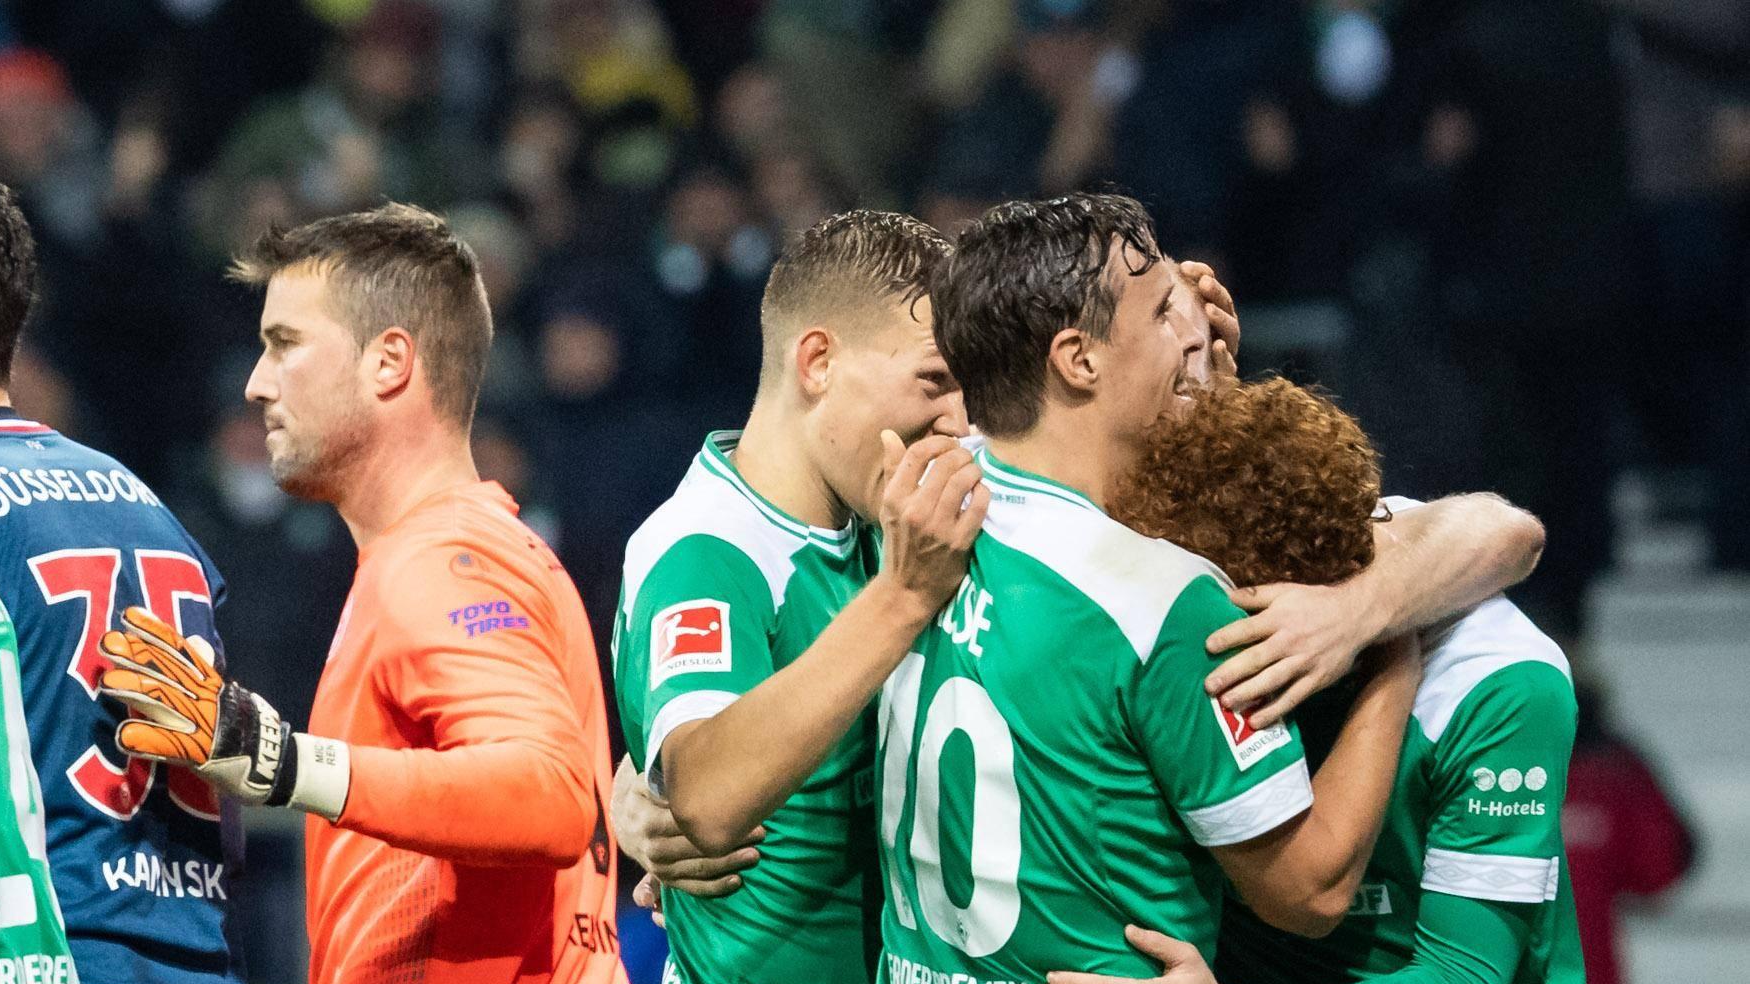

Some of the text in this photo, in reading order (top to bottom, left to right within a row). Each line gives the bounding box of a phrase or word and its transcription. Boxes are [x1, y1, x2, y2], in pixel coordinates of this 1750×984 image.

[448, 601, 510, 625] TOYO
[464, 617, 529, 637] TIRES
[1468, 798, 1546, 817] H-Hotels
